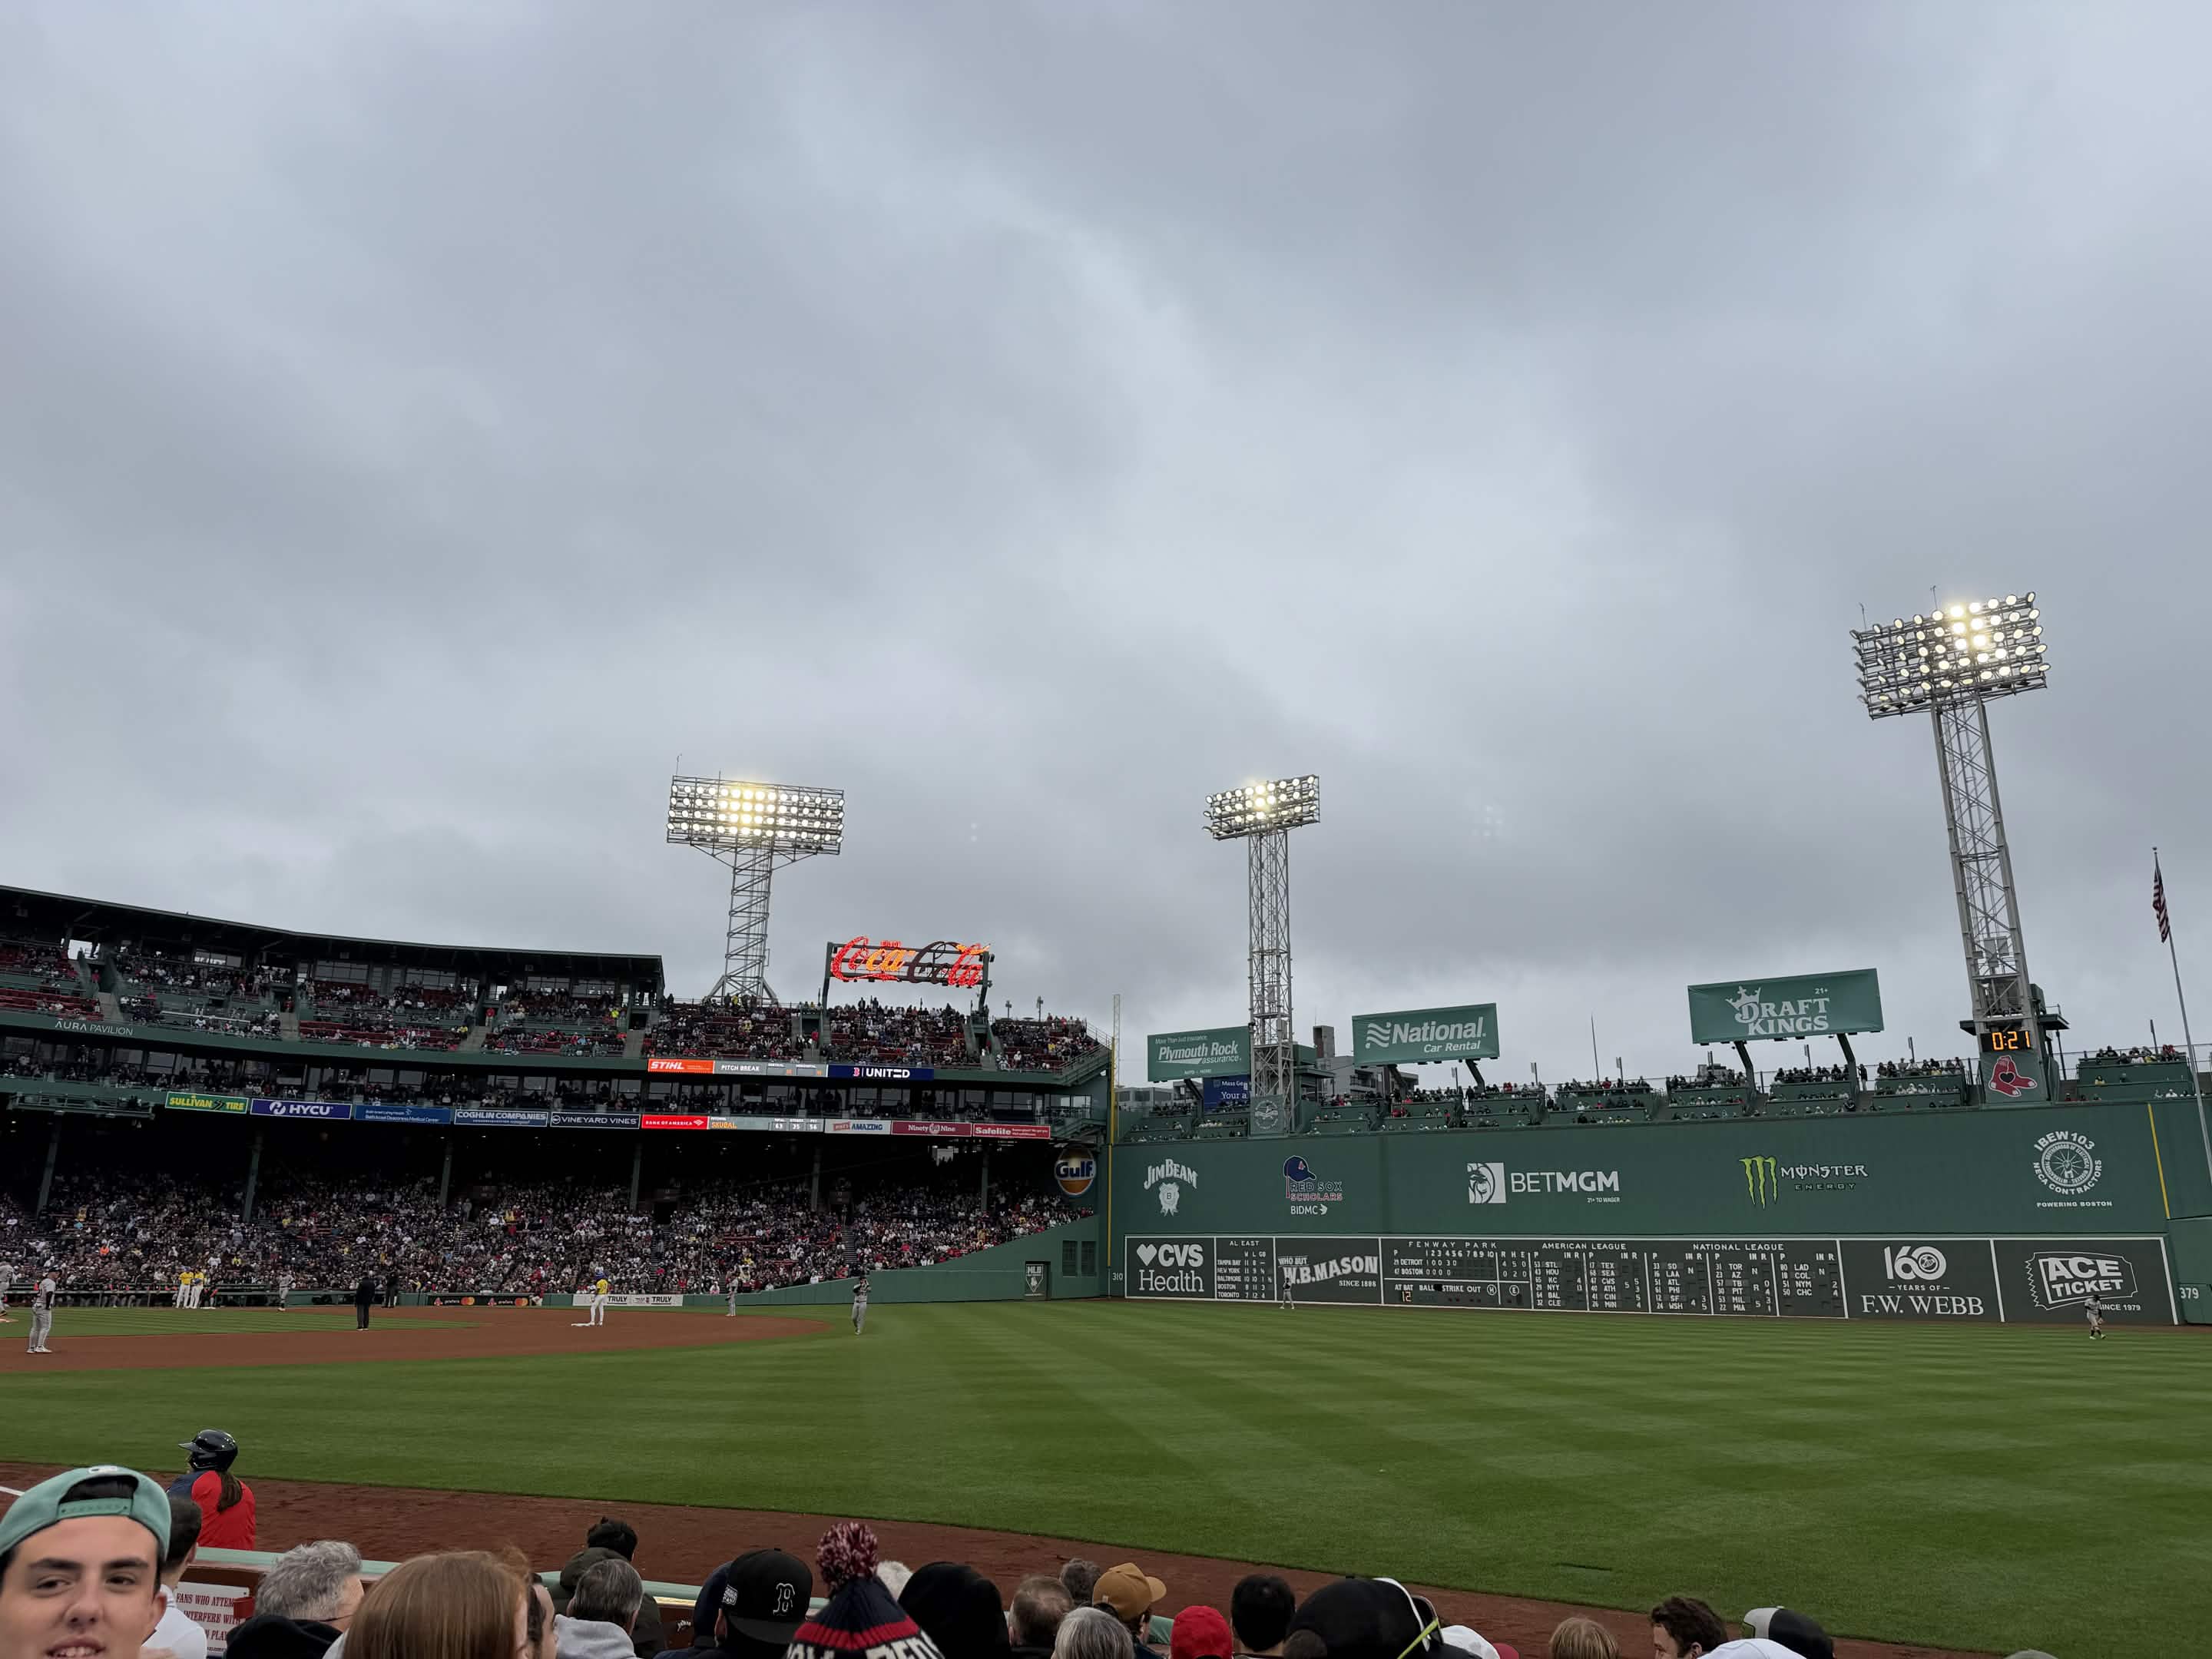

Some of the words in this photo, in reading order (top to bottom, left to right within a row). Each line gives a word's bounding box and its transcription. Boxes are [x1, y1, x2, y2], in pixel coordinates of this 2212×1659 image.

[830, 935, 991, 986] Coca-Cola
[1734, 998, 1830, 1024] DRAFT
[55, 1020, 88, 1032] AURA
[89, 1025, 134, 1037] PAVILION
[1392, 1016, 1485, 1045] National
[1748, 1015, 1830, 1036] KINGS
[1424, 1043, 1442, 1053] Car
[1445, 1041, 1481, 1051] Rental
[1992, 1031, 2031, 1051] 0:21
[1158, 1042, 1208, 1061] Plymouth
[1210, 1040, 1239, 1056] Rock
[651, 1061, 684, 1070] STIHL
[1201, 1055, 1240, 1064] assurance
[866, 1068, 910, 1078] UNITED
[169, 1096, 212, 1108] SULLIVAN
[226, 1101, 246, 1111] TIRE
[1221, 1091, 1240, 1100] Your
[290, 1104, 331, 1116] HYCU
[561, 1116, 608, 1124] VINEYARD
[975, 1127, 1012, 1135] Safelite
[2033, 1131, 2068, 1152] IBEW
[2070, 1132, 2095, 1151] 103
[1056, 1161, 1094, 1178] Gulf
[1144, 1165, 1165, 1190] JIM
[1165, 1158, 1199, 1190] BEAM
[1780, 1164, 1869, 1180] MONSTER
[2033, 1162, 2048, 1185] NECA
[2048, 1160, 2102, 1195] CONTRACTORS
[1290, 1181, 1315, 1193] RED
[1318, 1181, 1343, 1192] SOX
[1510, 1171, 1620, 1193] BETMGM
[1290, 1192, 1343, 1202] SCHOLARS
[1290, 1205, 1319, 1215] BIDMC
[1157, 1243, 1204, 1268] CVS
[1278, 1257, 1293, 1265] WHO
[1295, 1257, 1308, 1265] BUT
[1884, 1246, 1947, 1280] 160
[1112, 1272, 1124, 1281] 310
[2047, 1256, 2122, 1282] ACE
[1138, 1269, 1205, 1293] Health
[2051, 1279, 2124, 1297] TICKET
[1402, 1290, 1412, 1303] 12
[2179, 1286, 2200, 1300] 379
[1861, 1295, 1904, 1314] F.W.
[1909, 1295, 1985, 1316] WEBB
[2123, 1303, 2141, 1312] 1979
[176, 1592, 194, 1604] FANS
[195, 1594, 210, 1606] WHO
[773, 1582, 796, 1616] B
